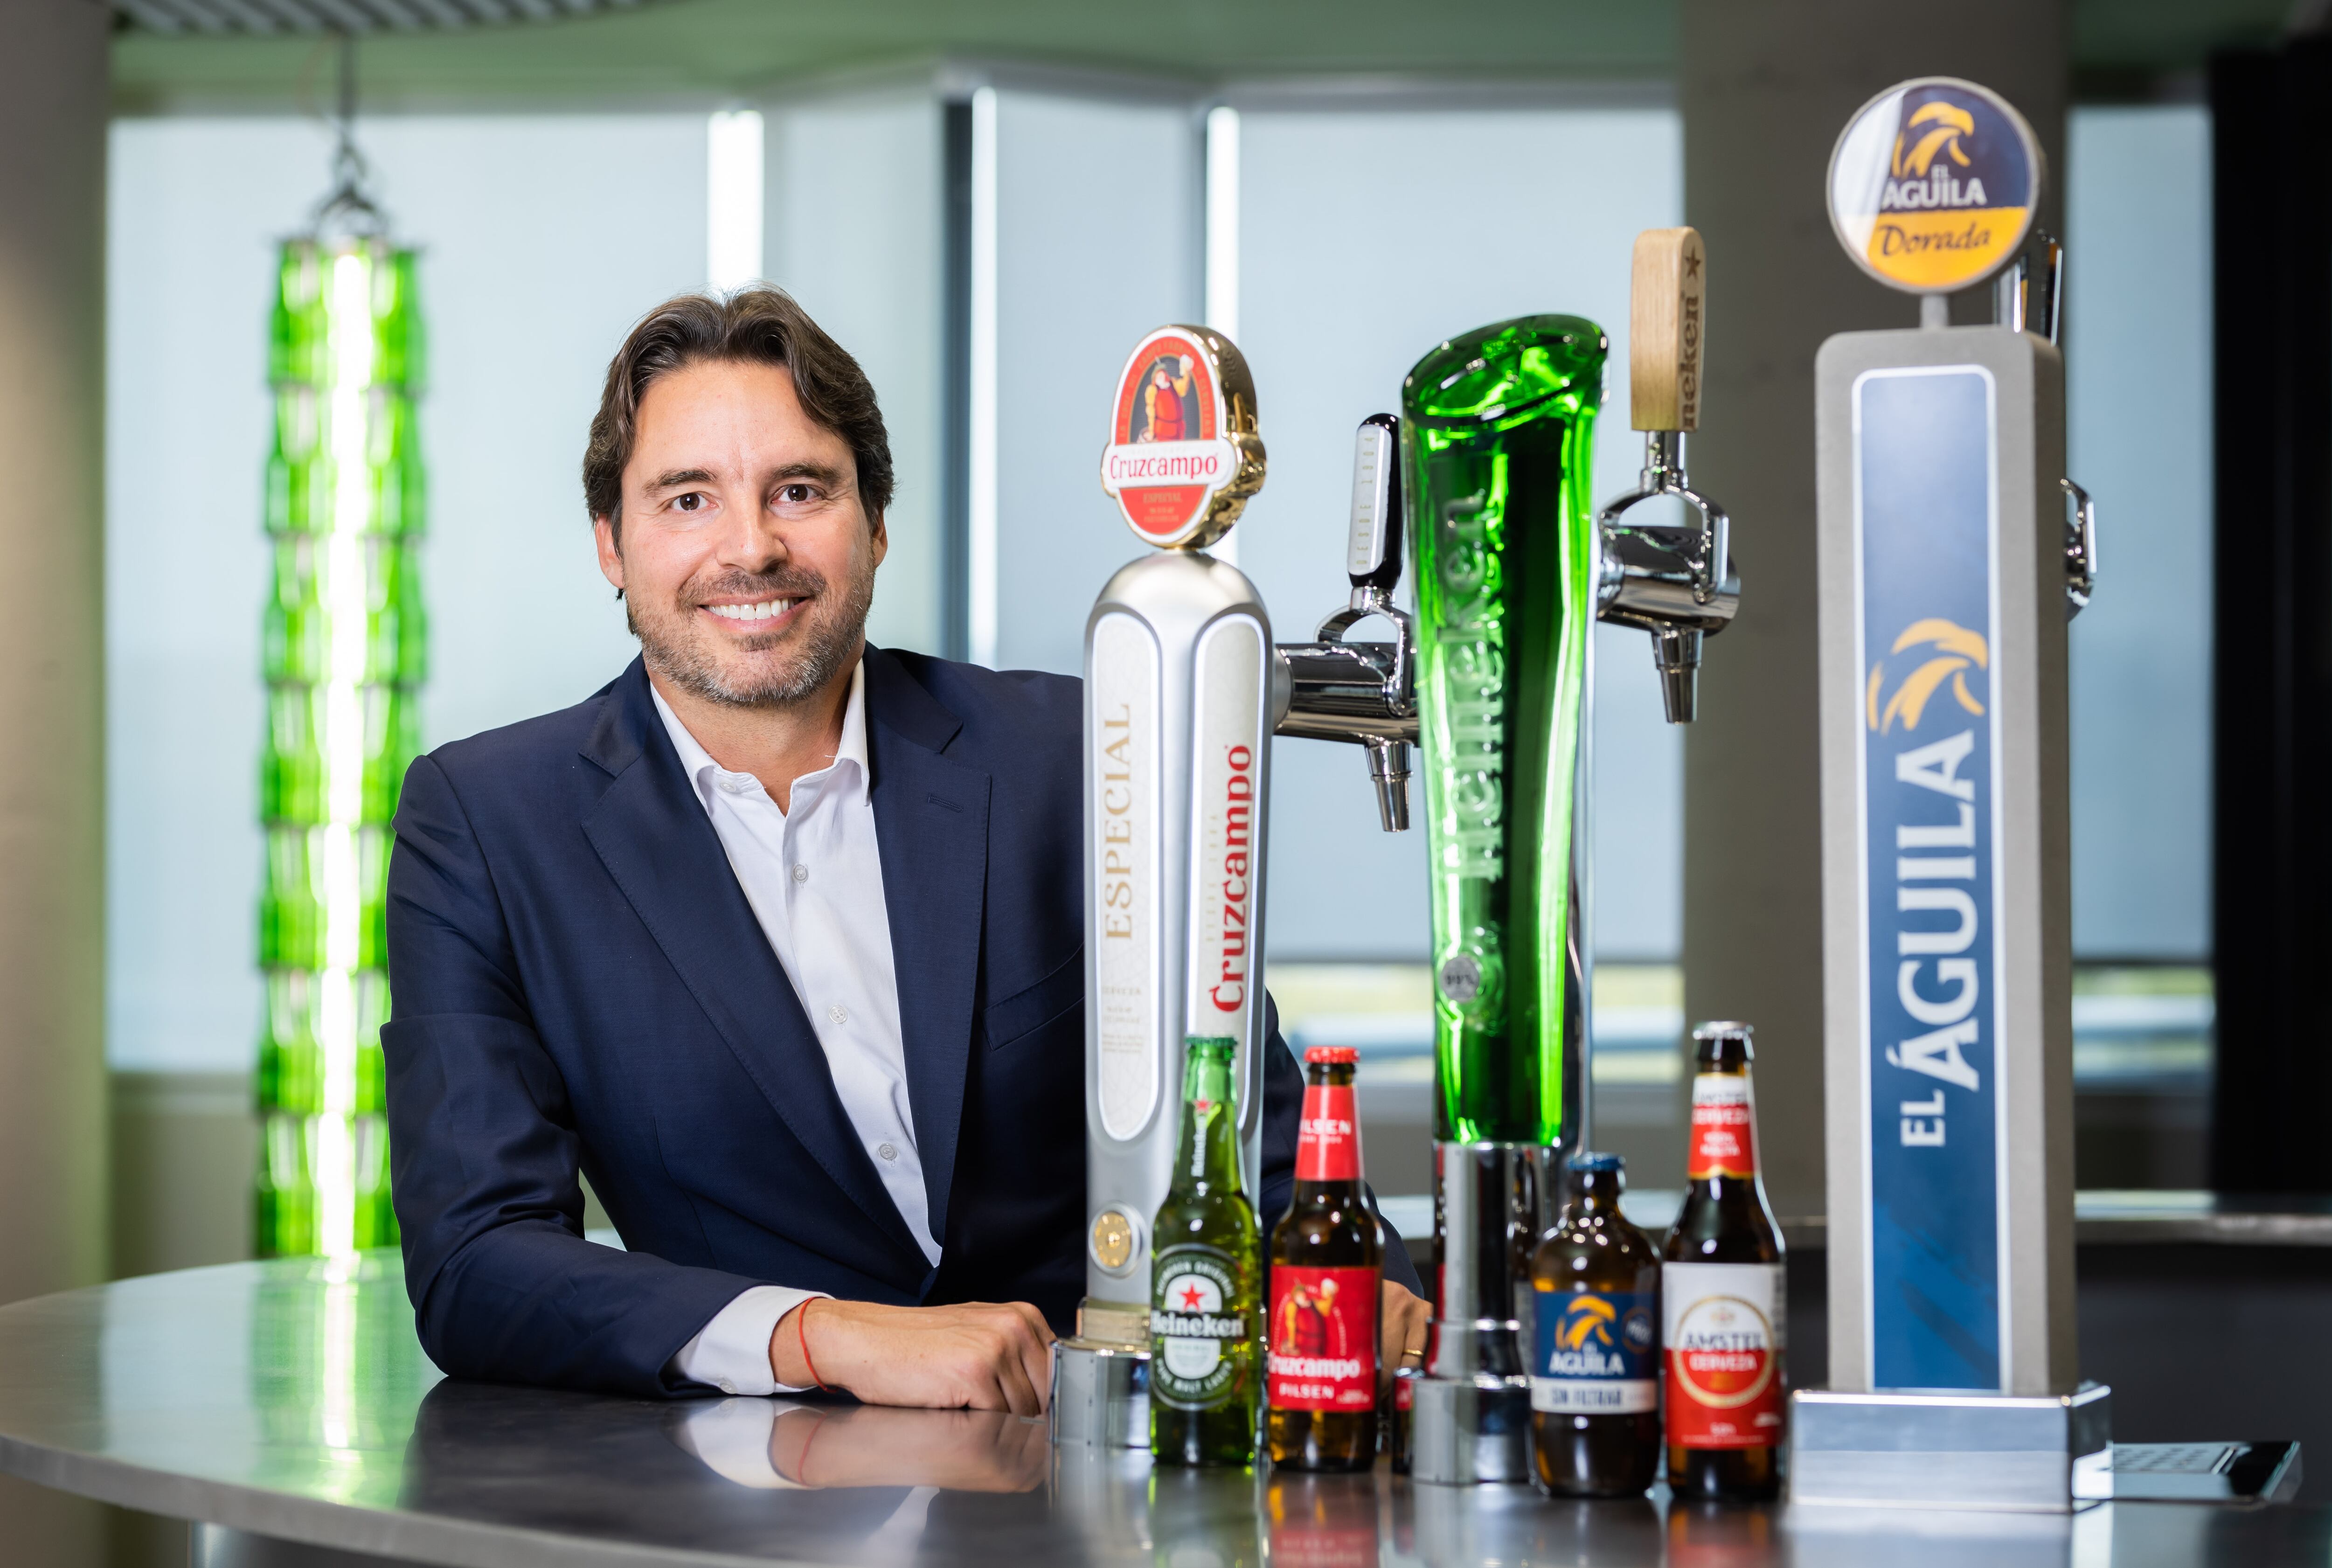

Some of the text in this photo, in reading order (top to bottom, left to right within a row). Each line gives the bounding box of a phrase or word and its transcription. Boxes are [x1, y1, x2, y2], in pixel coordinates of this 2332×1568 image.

[1931, 164, 1950, 180] EL
[1878, 222, 1992, 257] Dorada
[1110, 452, 1219, 479] Cruzcampo
[1104, 703, 1132, 940] ESPECIAL
[1208, 744, 1254, 1013] Cruzcampo
[1885, 728, 1980, 1147] EL ÁGUILA
[1300, 1119, 1352, 1135] ILSEN
[1150, 1311, 1245, 1338] Heineken
[1279, 1382, 1335, 1400] PILSEN
